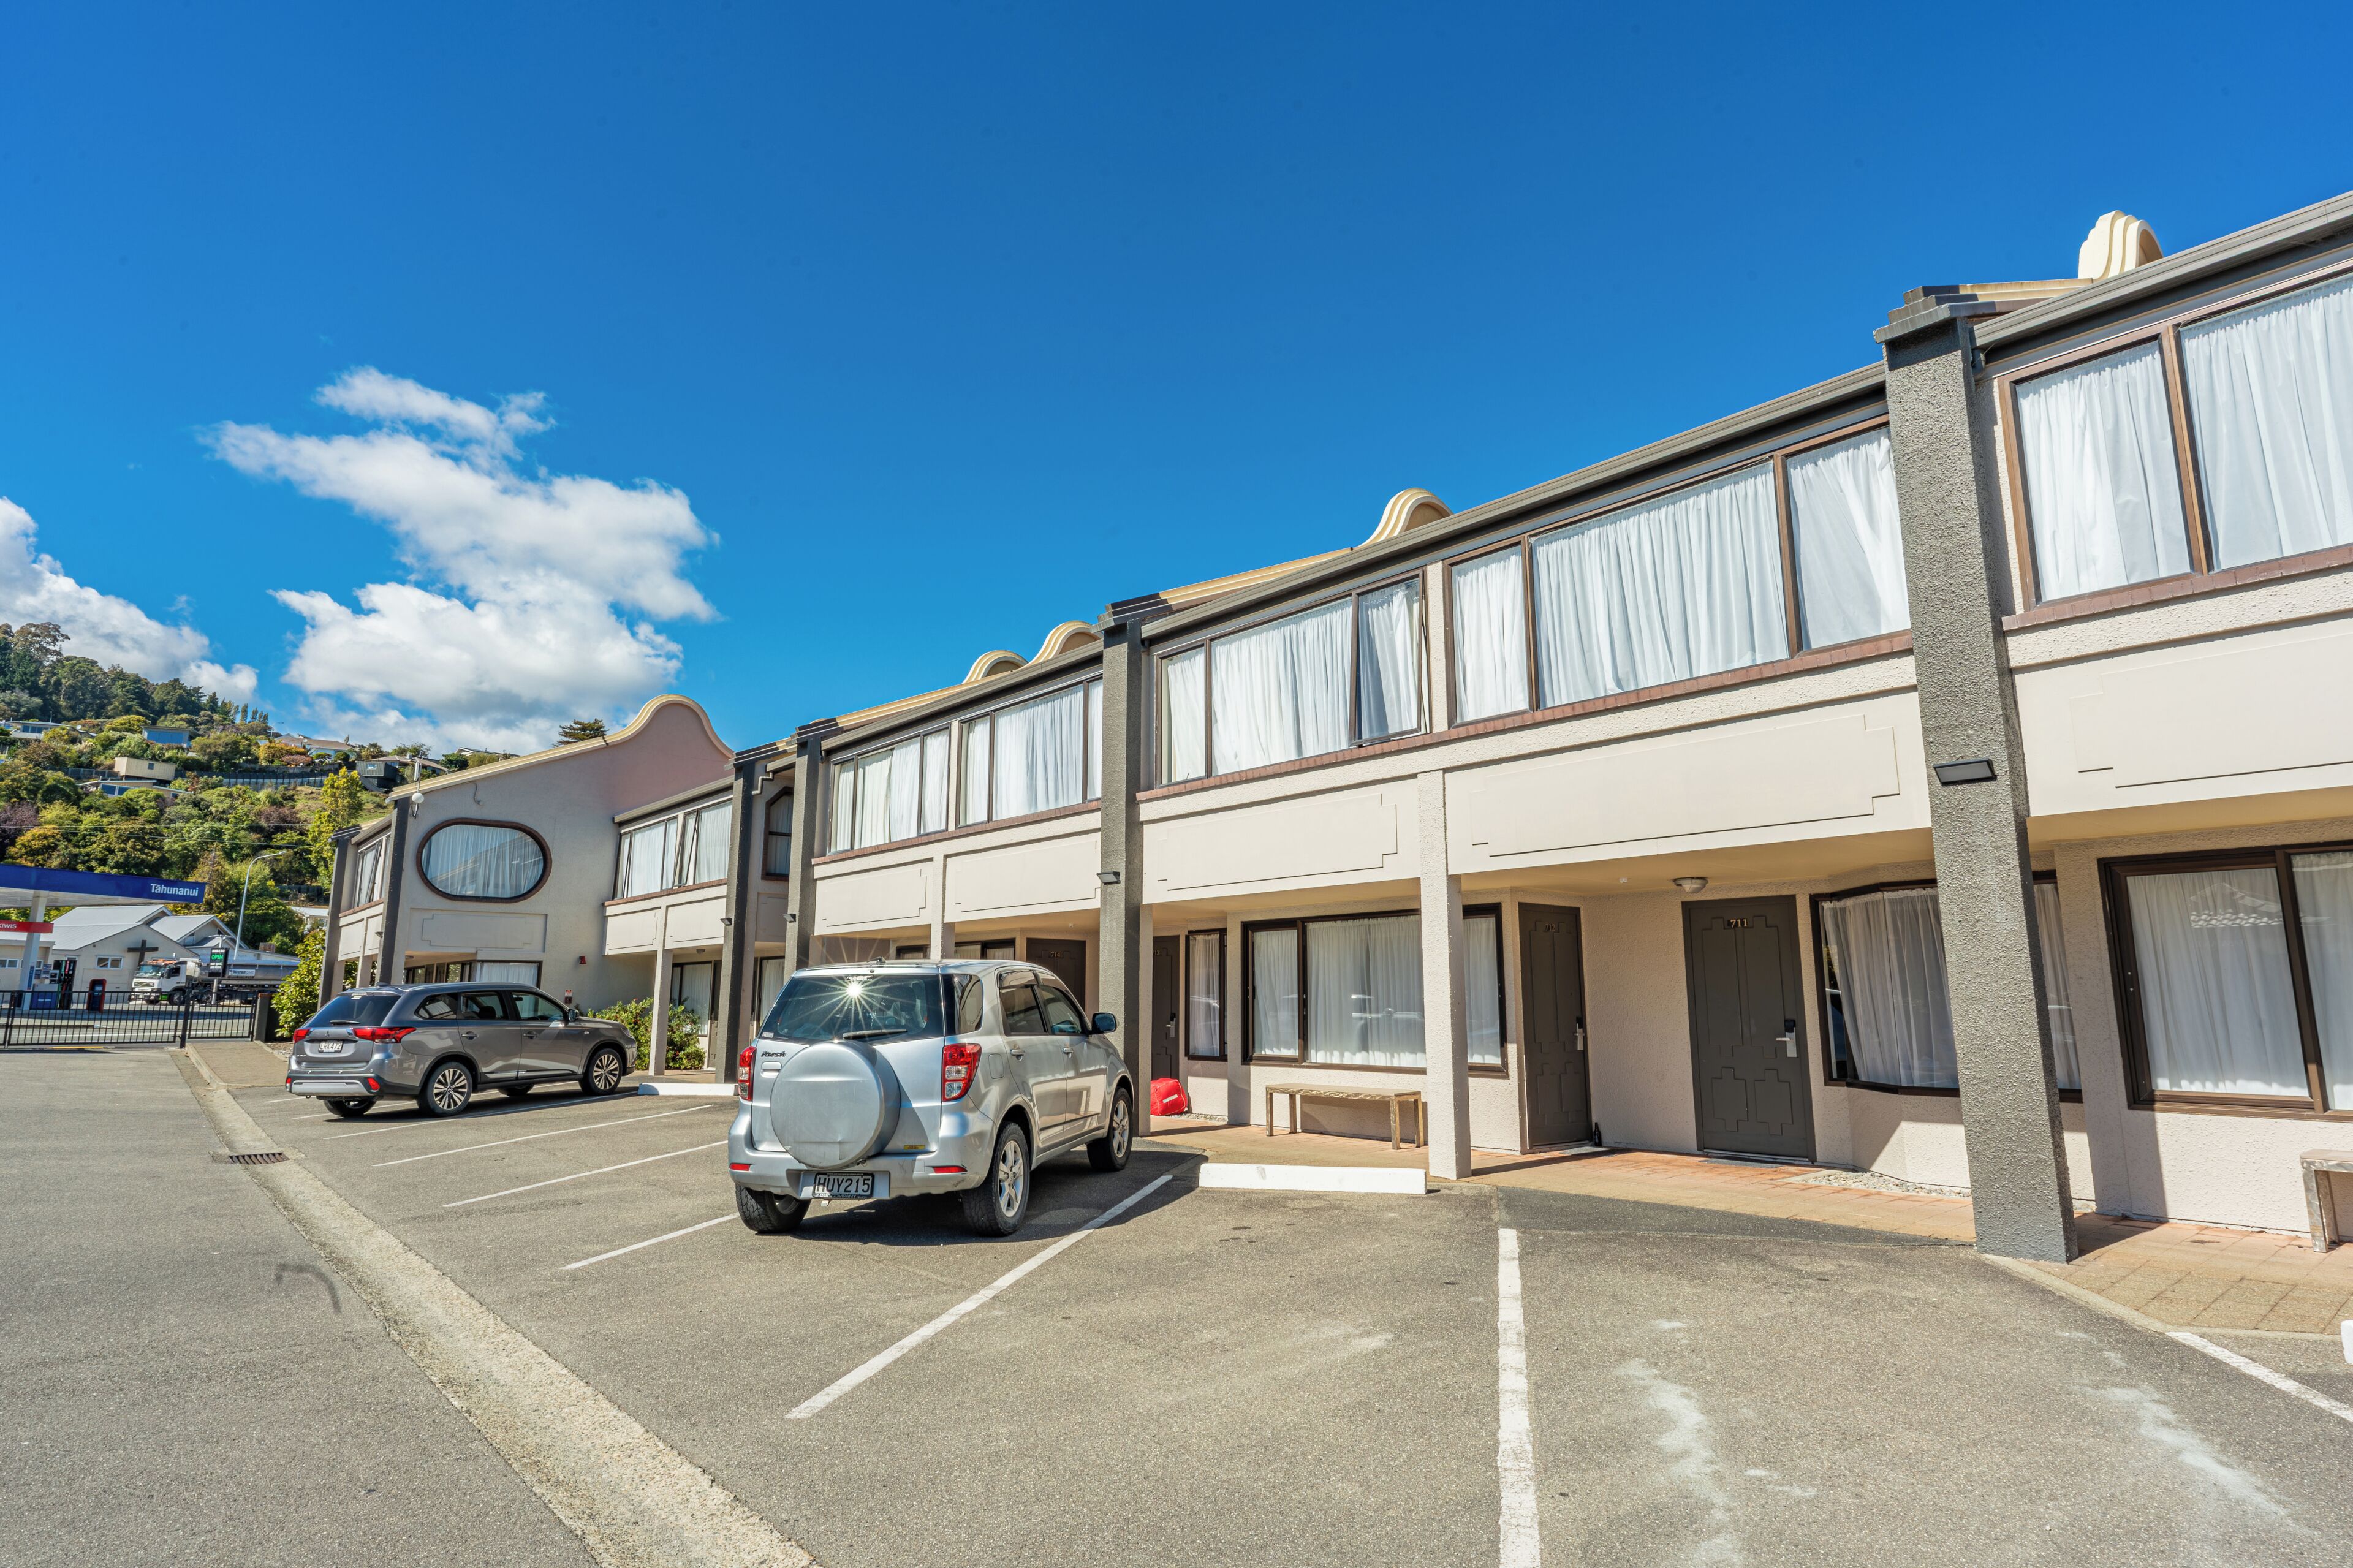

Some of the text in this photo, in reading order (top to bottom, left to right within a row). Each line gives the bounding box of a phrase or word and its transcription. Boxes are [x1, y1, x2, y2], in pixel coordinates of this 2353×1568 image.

[151, 884, 199, 896] Tāhunanui
[1730, 919, 1748, 928] 711
[817, 1177, 870, 1193] HUY215
